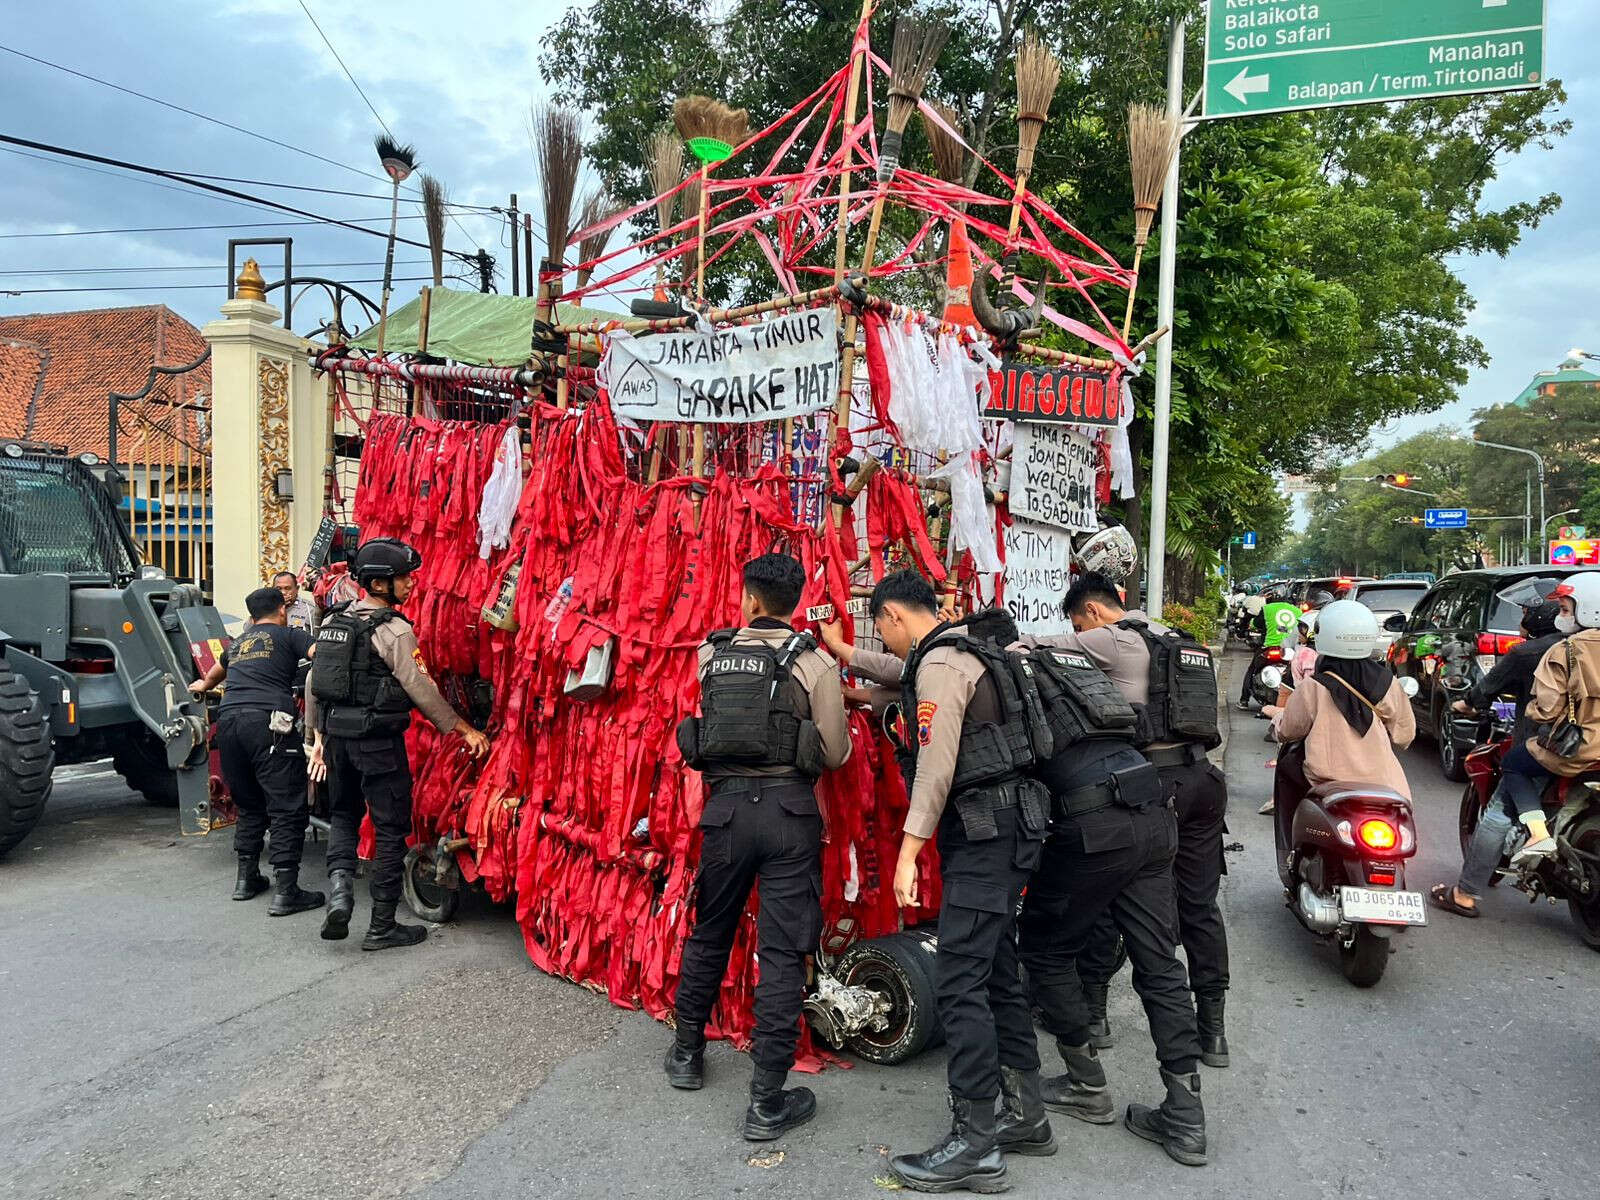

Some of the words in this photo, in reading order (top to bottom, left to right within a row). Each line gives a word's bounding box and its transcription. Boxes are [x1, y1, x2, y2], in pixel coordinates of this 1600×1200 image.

[1225, 3, 1320, 30] Balaikota
[1224, 32, 1267, 51] Solo
[1275, 22, 1331, 45] Safari
[1428, 40, 1524, 64] Manahan
[1287, 79, 1363, 101] Balapan
[649, 332, 742, 365] JAKARTA
[750, 313, 824, 351] TIMUR
[621, 379, 653, 397] AWAS
[1021, 530, 1053, 561] TIM
[319, 630, 348, 642] POLISI
[712, 657, 765, 673] POLISI
[1055, 656, 1091, 668] SPARTA
[1180, 654, 1210, 668] SPARTA
[1345, 890, 1360, 903] AD
[1364, 892, 1395, 905] 3065
[1397, 894, 1421, 907] AAE
